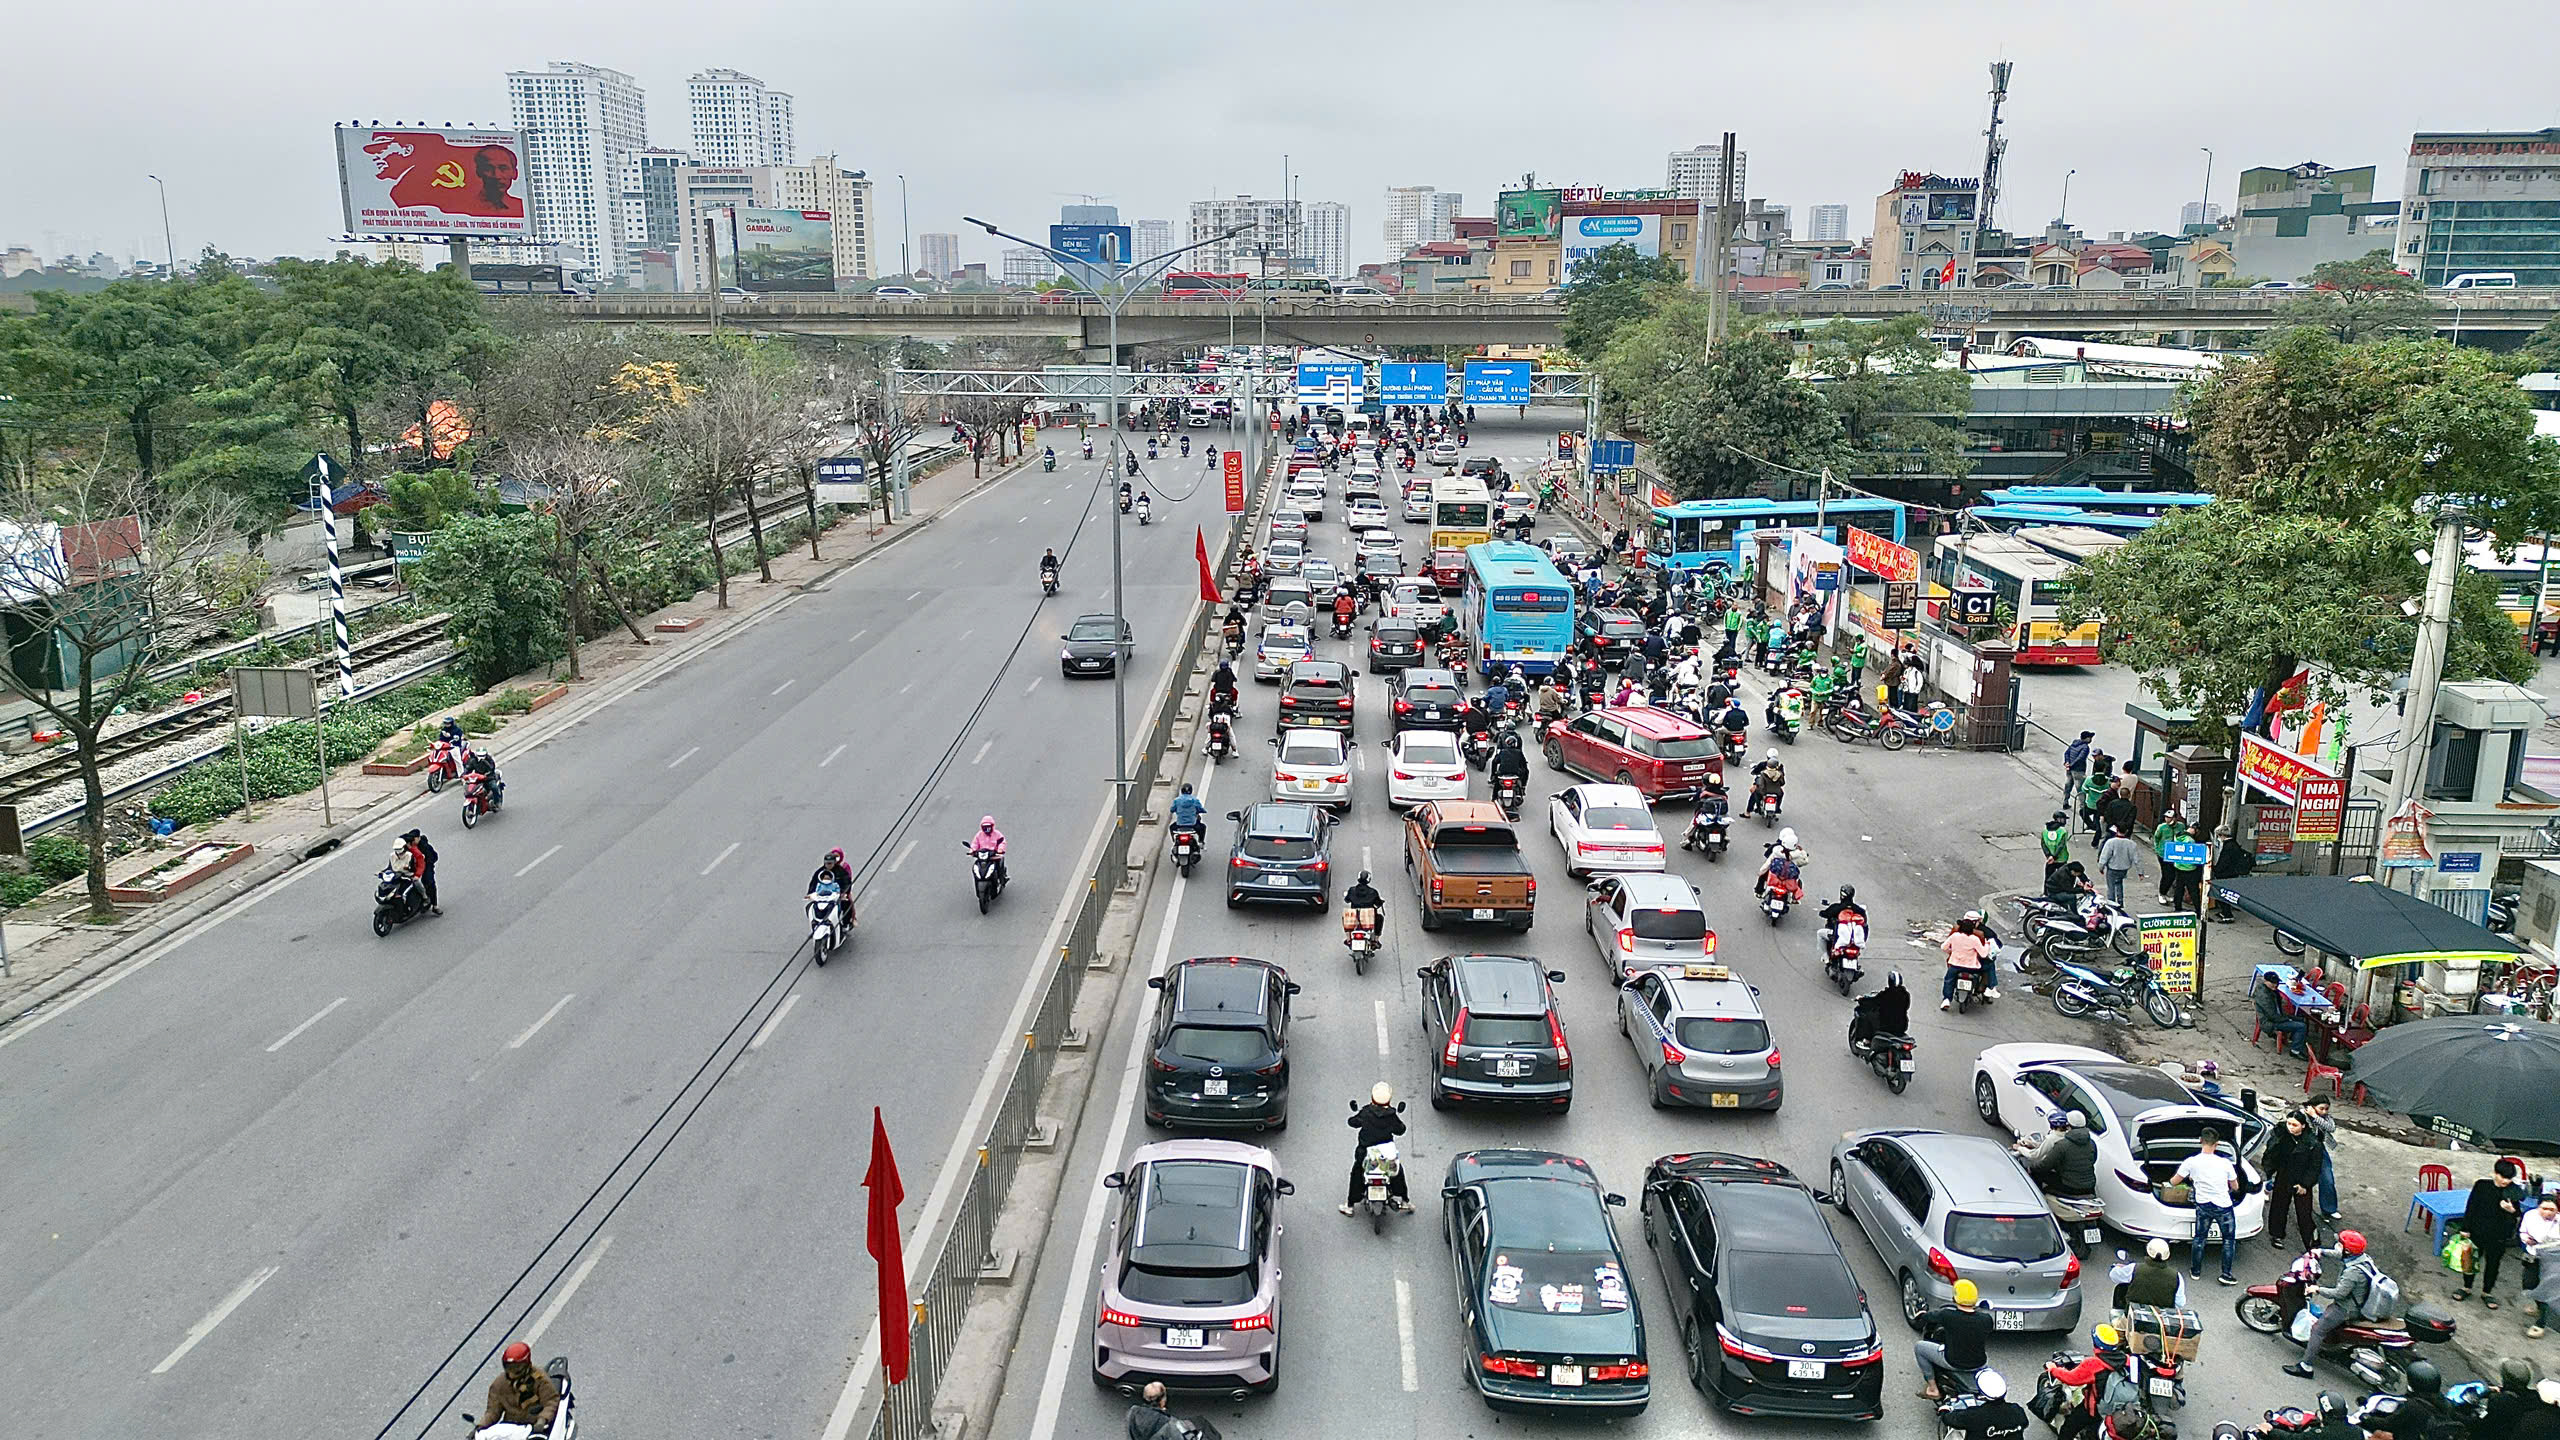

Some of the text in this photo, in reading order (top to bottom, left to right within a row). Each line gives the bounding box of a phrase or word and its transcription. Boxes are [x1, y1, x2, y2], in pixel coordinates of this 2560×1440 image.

[1562, 182, 1678, 201] BẾP TỪ eurosun
[745, 224, 793, 233] GAMUDA LAND
[1951, 592, 1961, 610] C1
[1967, 597, 1992, 614] C1
[1966, 615, 1989, 623] Gate
[2305, 780, 2339, 795] NHÀ
[2300, 795, 2341, 810] NGHỈ
[2259, 821, 2290, 832] NGH
[2142, 917, 2193, 928] CƯỜNG HIỆP
[2142, 930, 2165, 940] NHÀ
[2165, 969, 2192, 980] TÔM
[2002, 1310, 2018, 1320] 29A
